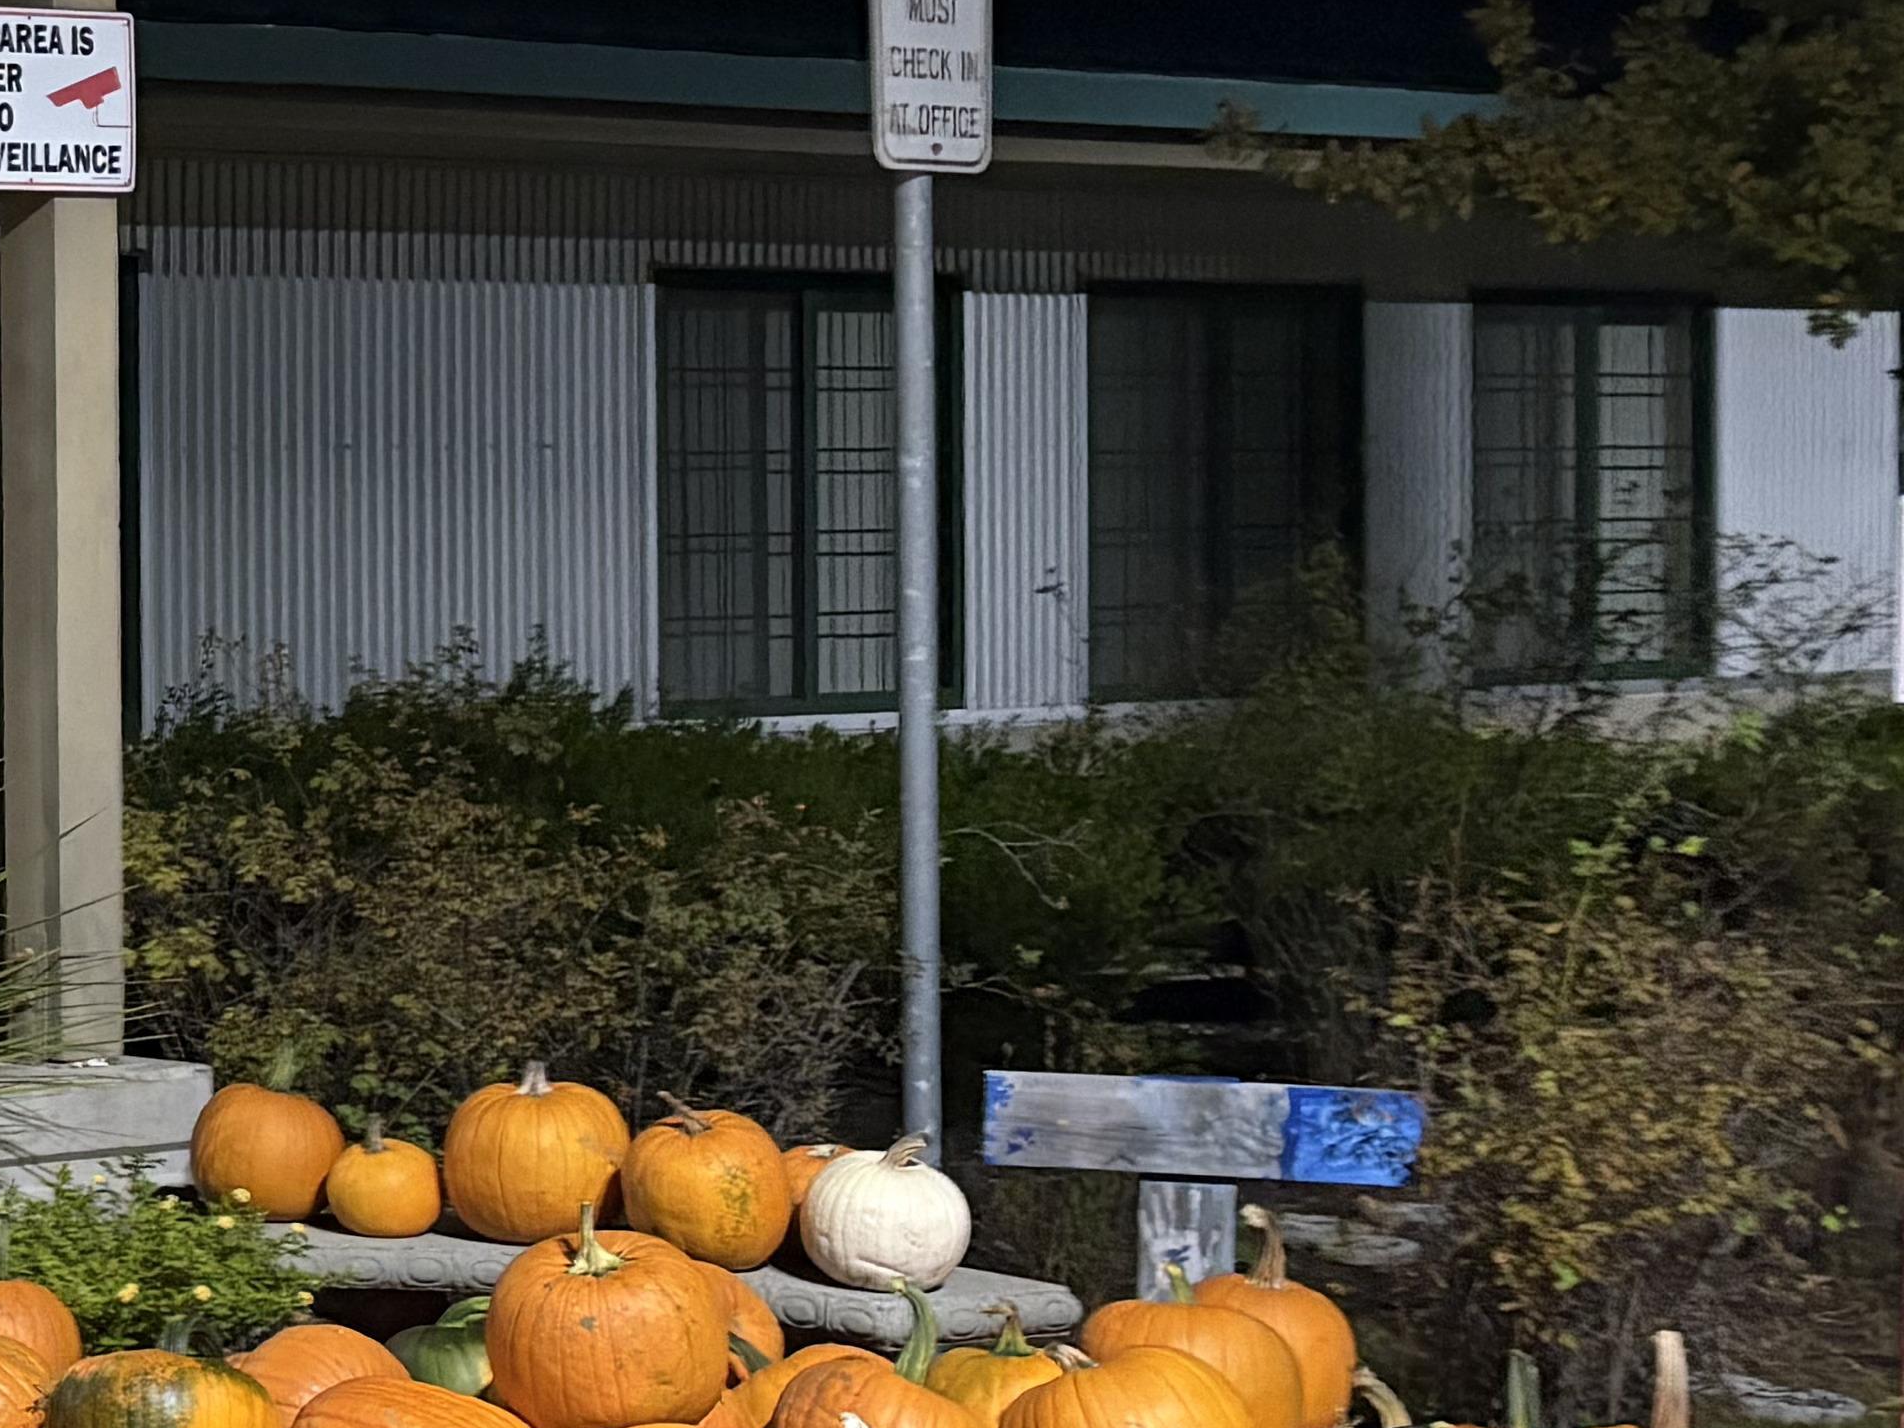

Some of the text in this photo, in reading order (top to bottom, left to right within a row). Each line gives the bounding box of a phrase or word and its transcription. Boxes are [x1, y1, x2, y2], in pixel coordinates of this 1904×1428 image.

[71, 26, 94, 56] IS
[889, 46, 980, 83] CHECK IN
[889, 103, 981, 139] AT OFFICE
